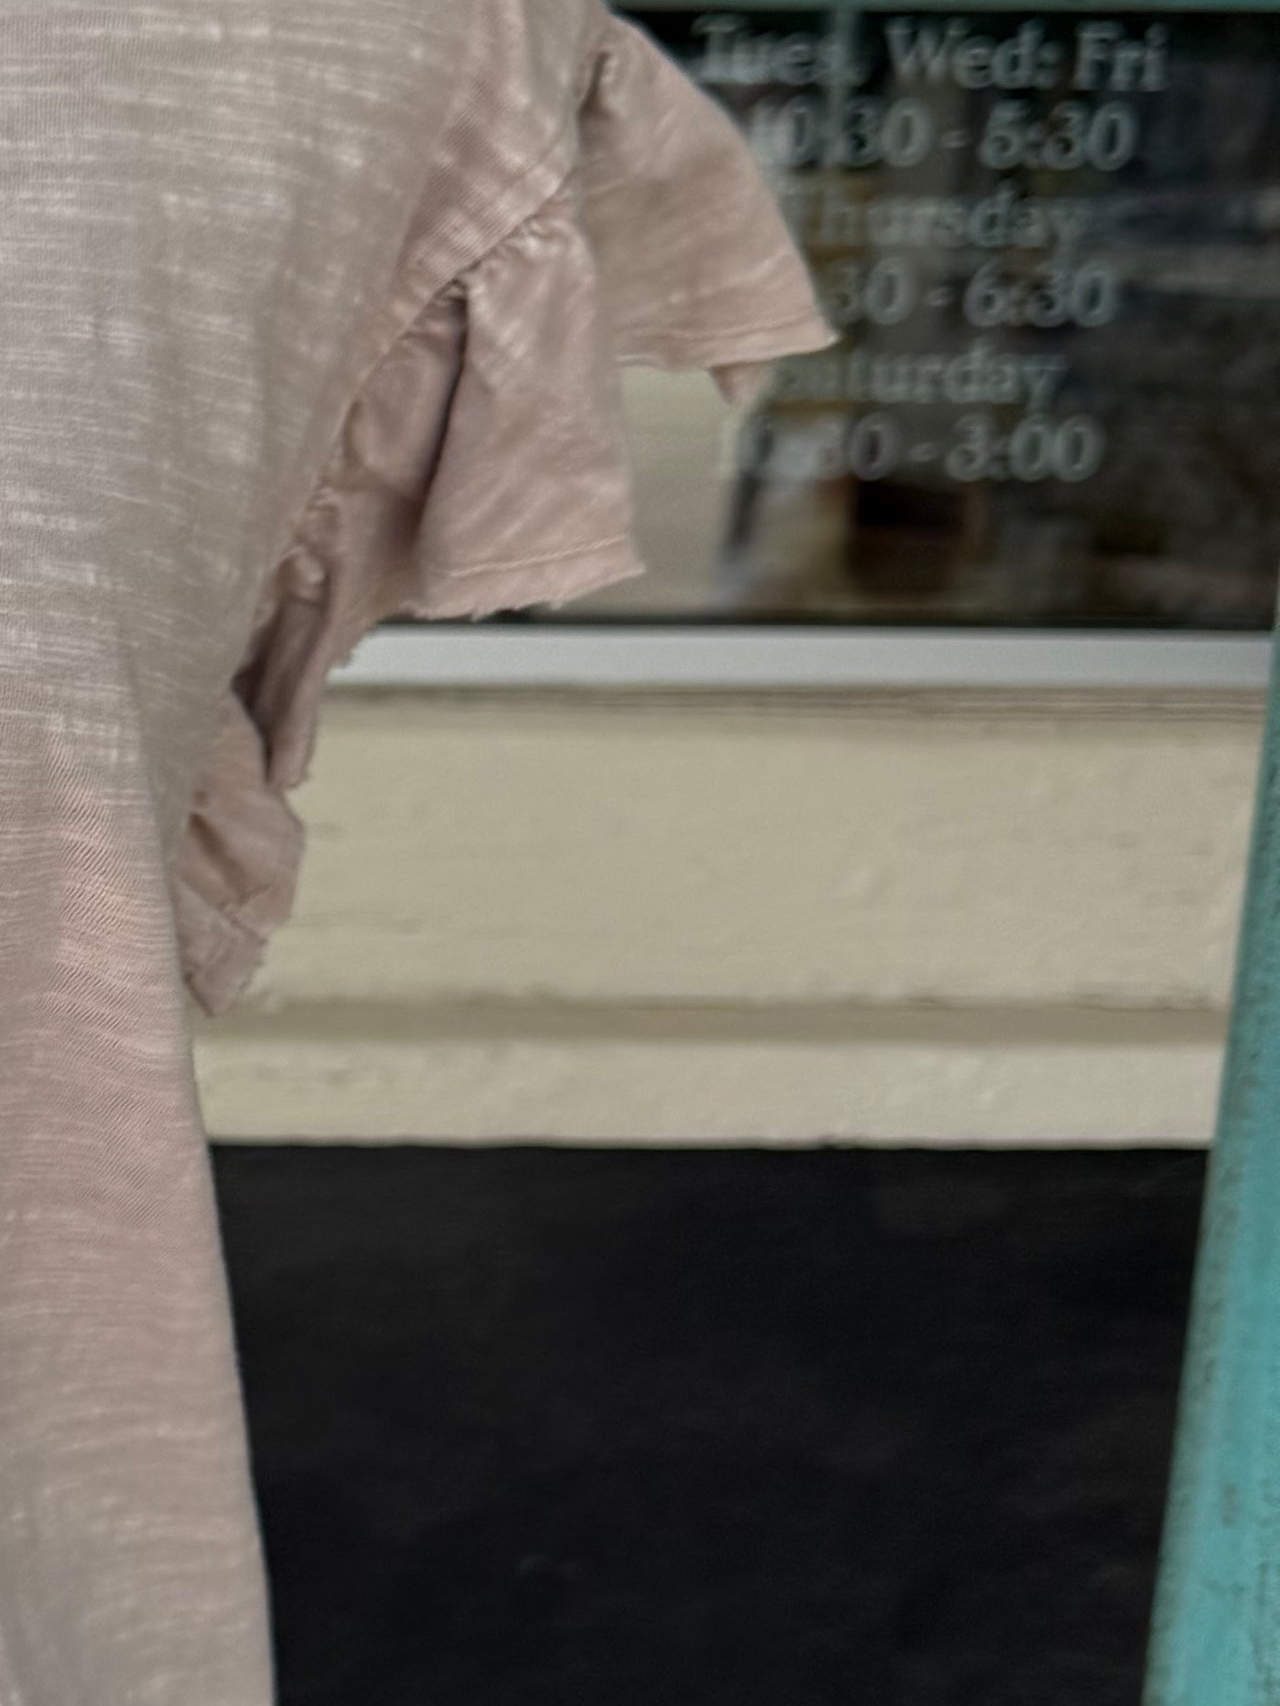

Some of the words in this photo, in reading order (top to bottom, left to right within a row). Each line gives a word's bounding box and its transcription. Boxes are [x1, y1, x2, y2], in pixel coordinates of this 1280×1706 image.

[1074, 20, 1169, 91] Fri
[978, 100, 1137, 171] 5:30
[962, 257, 1120, 329] 6:30
[944, 411, 1104, 483] 3:00
